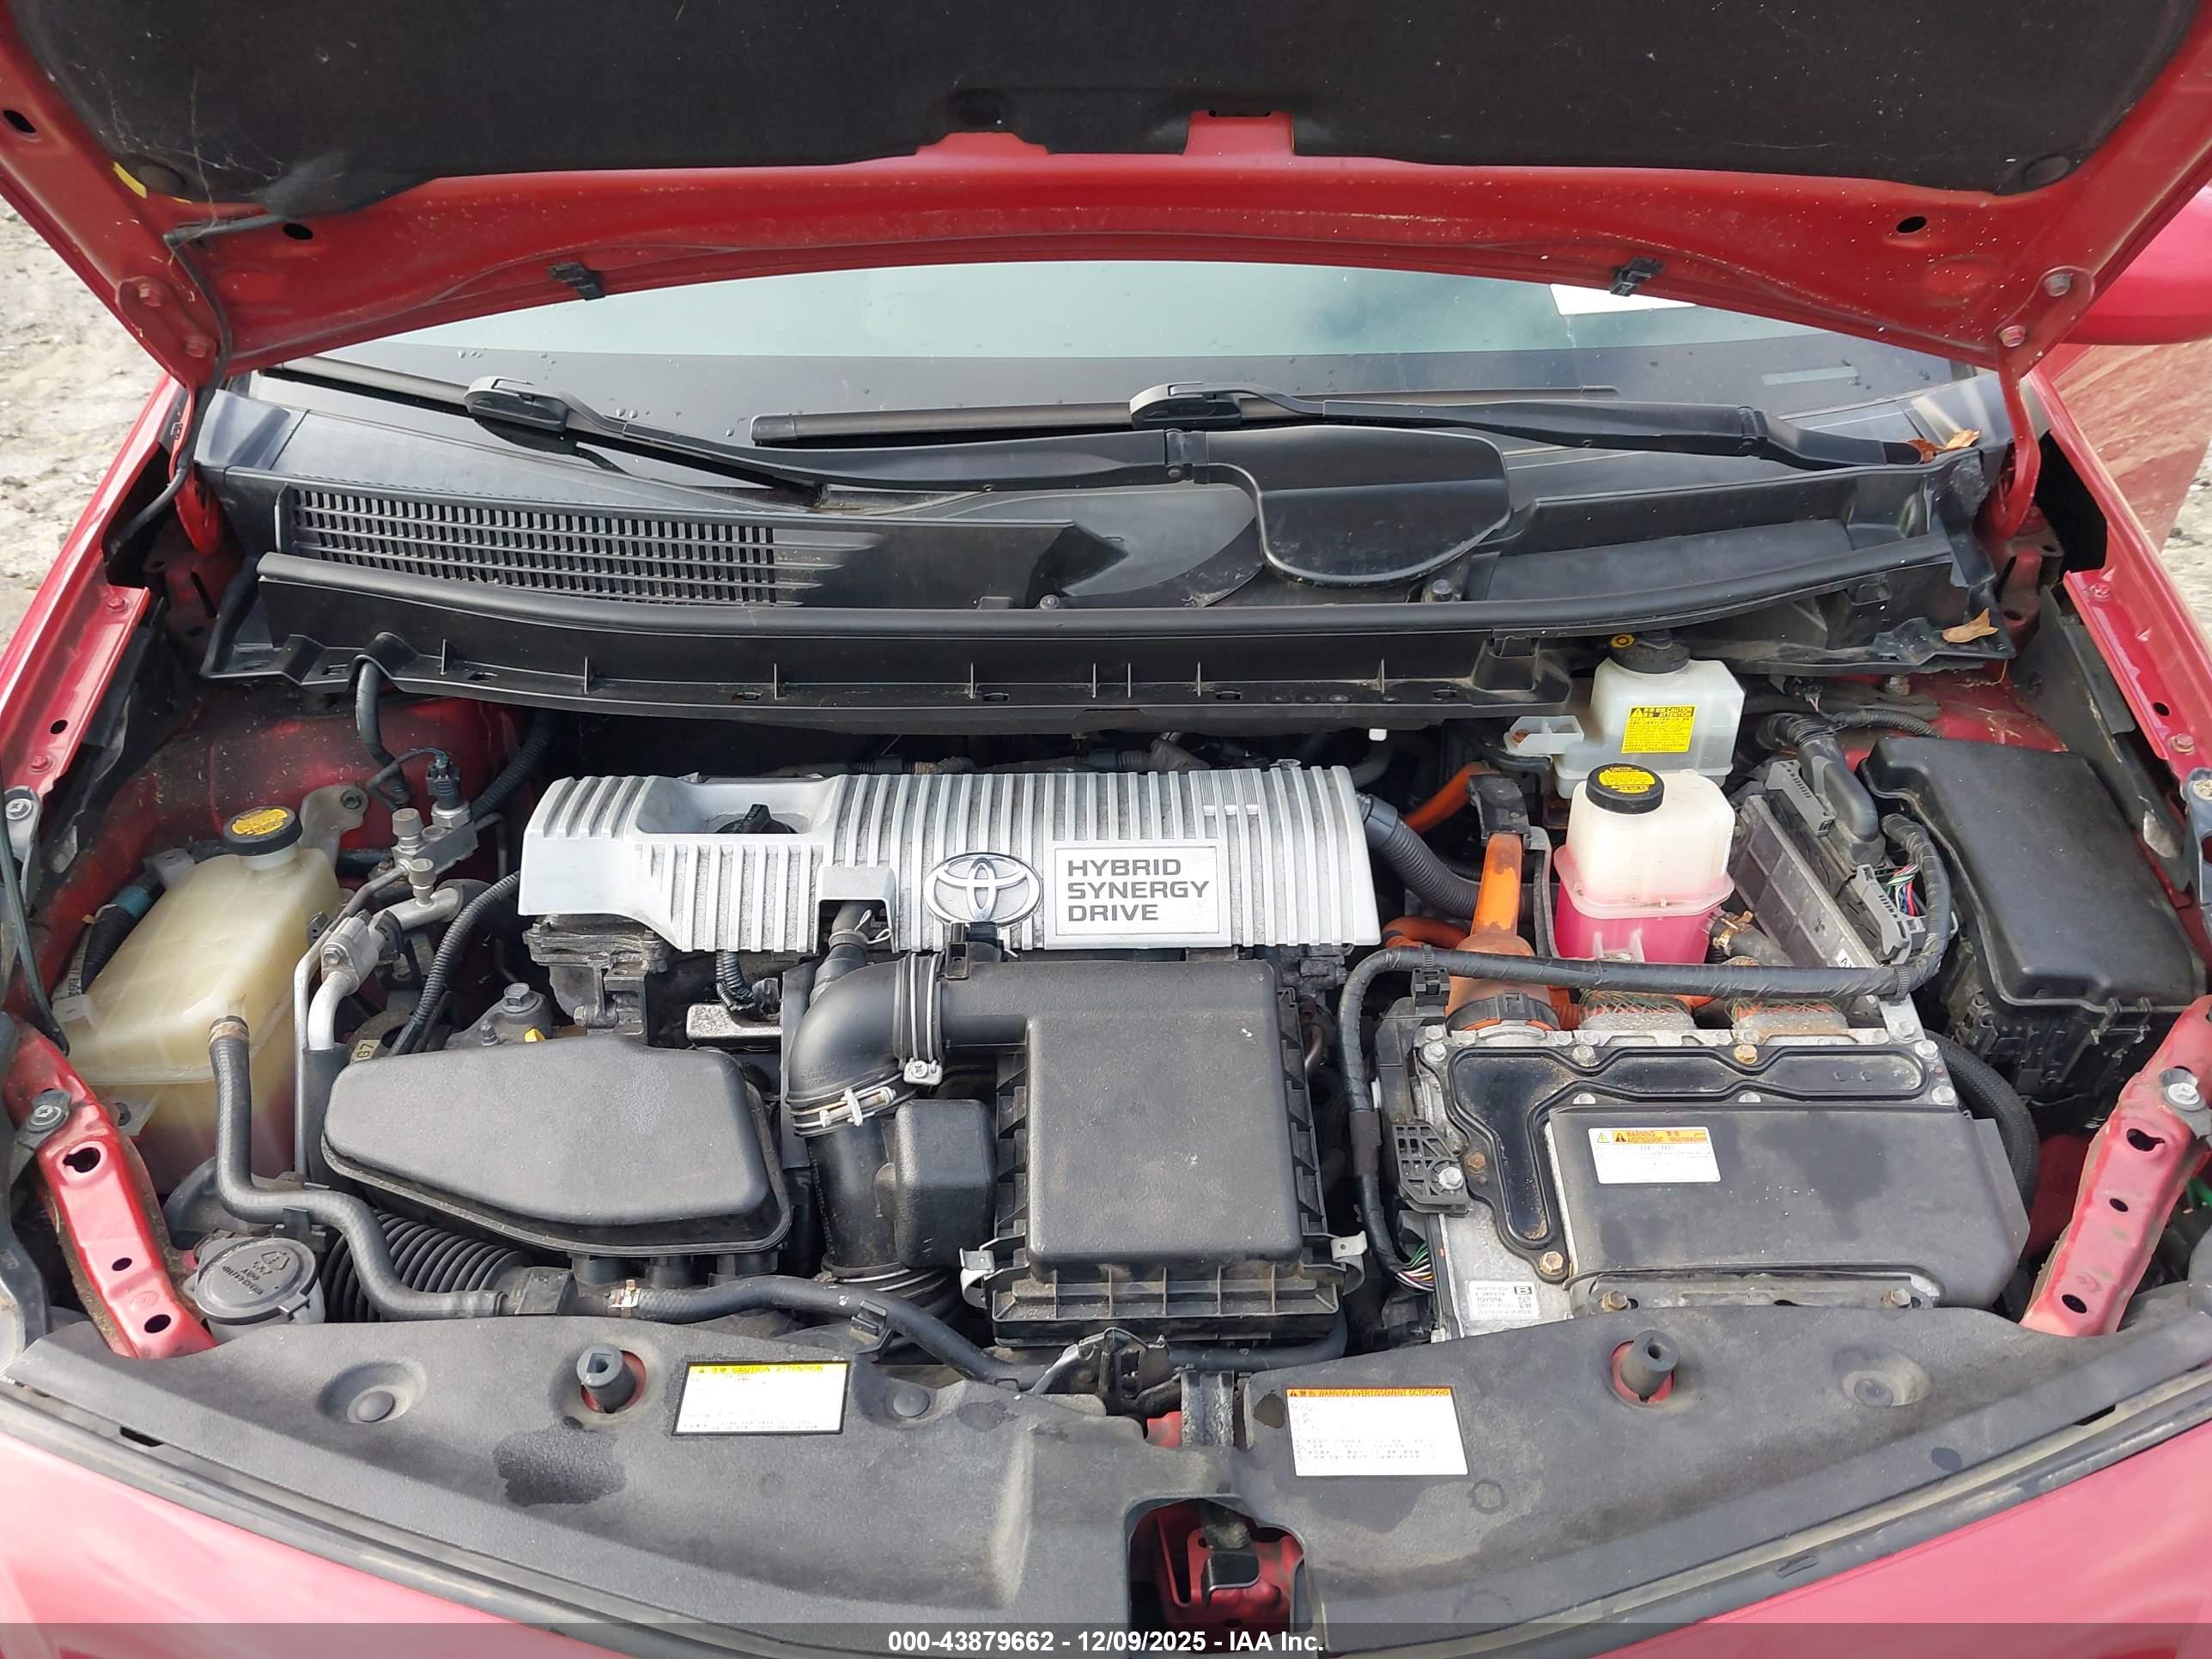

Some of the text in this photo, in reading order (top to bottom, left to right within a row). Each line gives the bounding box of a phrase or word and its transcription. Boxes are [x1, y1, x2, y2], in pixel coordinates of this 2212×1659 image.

[1067, 859, 1181, 877] HYBRID
[1067, 880, 1210, 899] SYNERGY
[1067, 904, 1158, 921] DRIVE
[356, 1042, 374, 1058] G7
